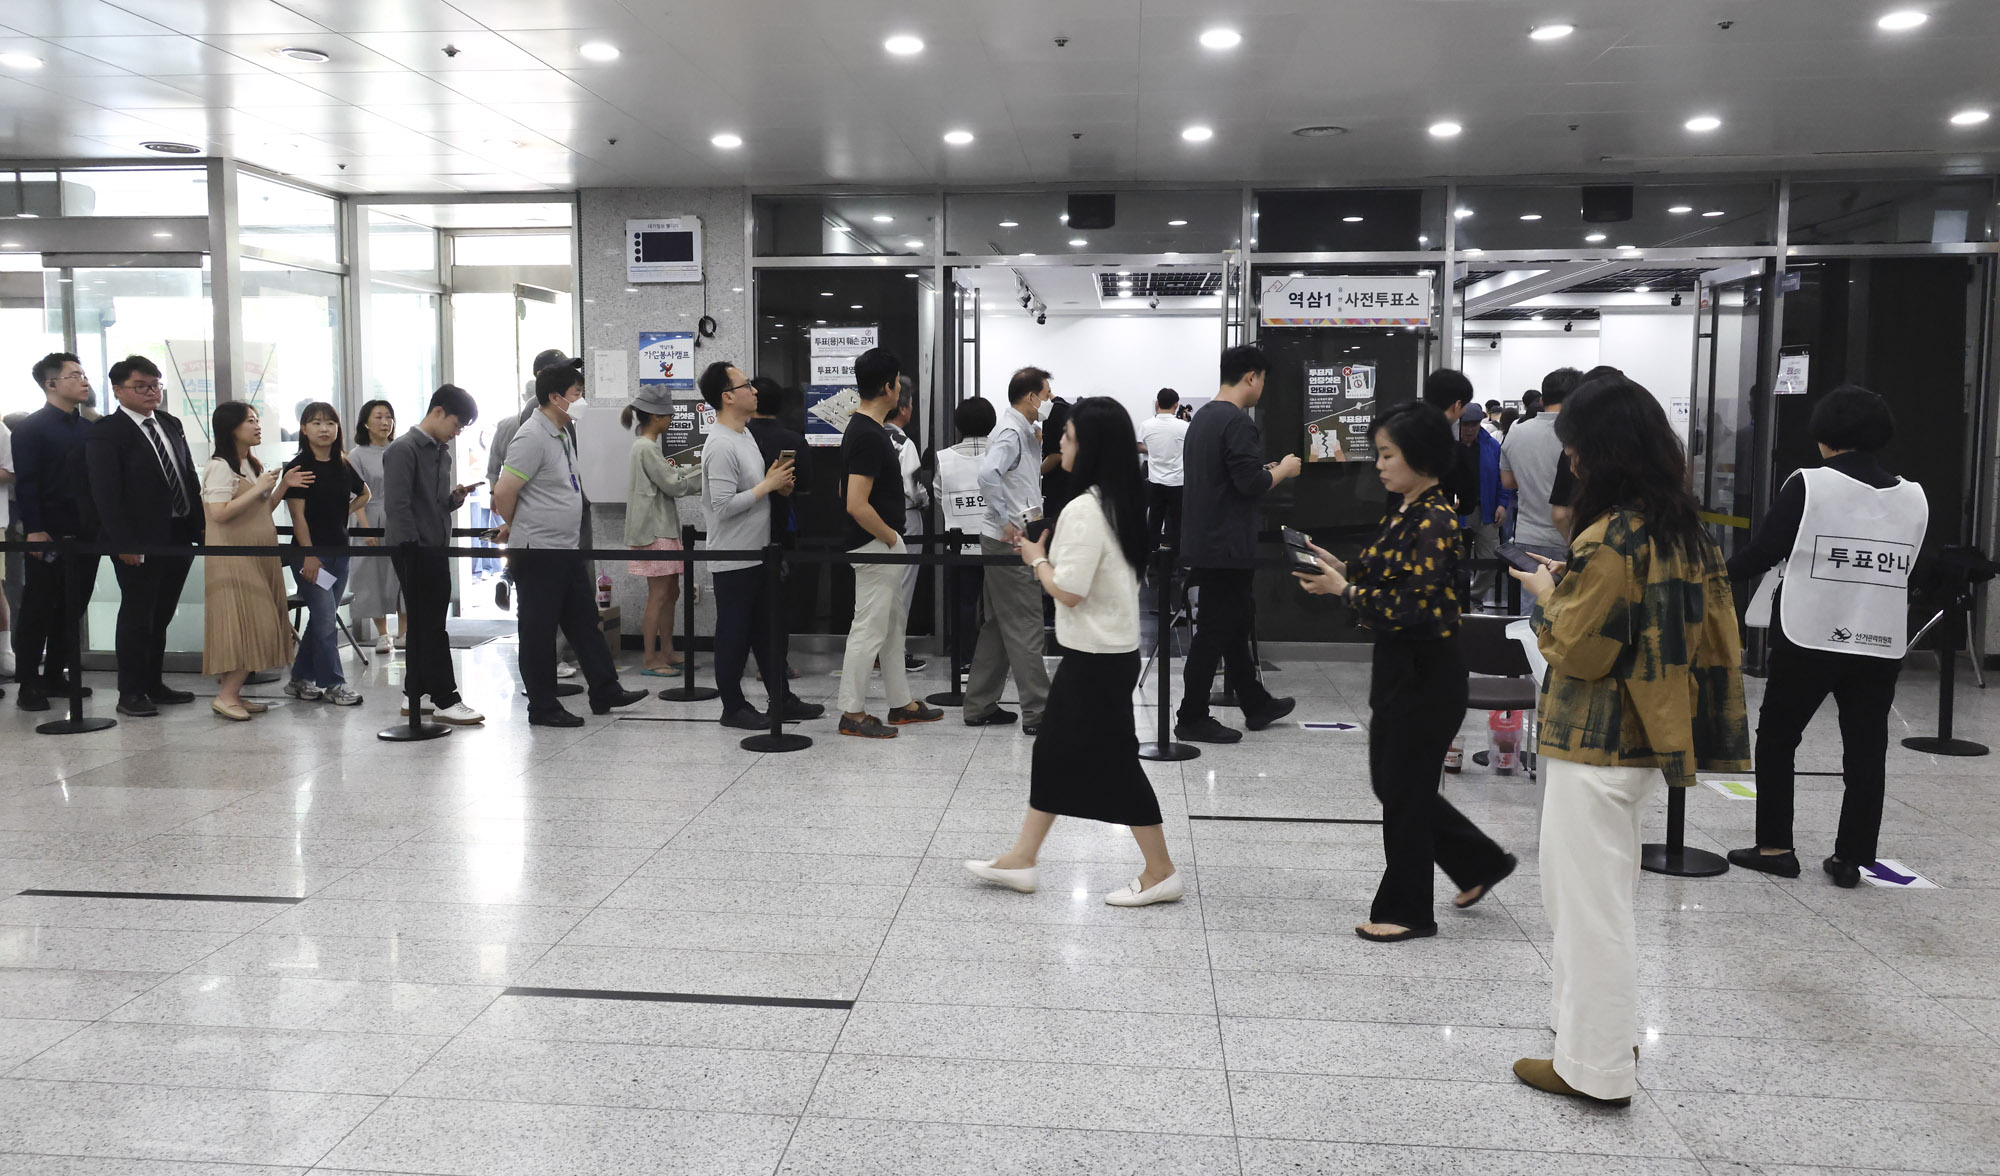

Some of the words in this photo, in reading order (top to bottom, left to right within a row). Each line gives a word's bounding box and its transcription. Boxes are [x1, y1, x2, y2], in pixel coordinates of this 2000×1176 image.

[1288, 291, 1332, 309] 역삼1
[1345, 291, 1420, 308] 사전투표소
[861, 336, 874, 346] 금지
[817, 366, 839, 375] 투표지
